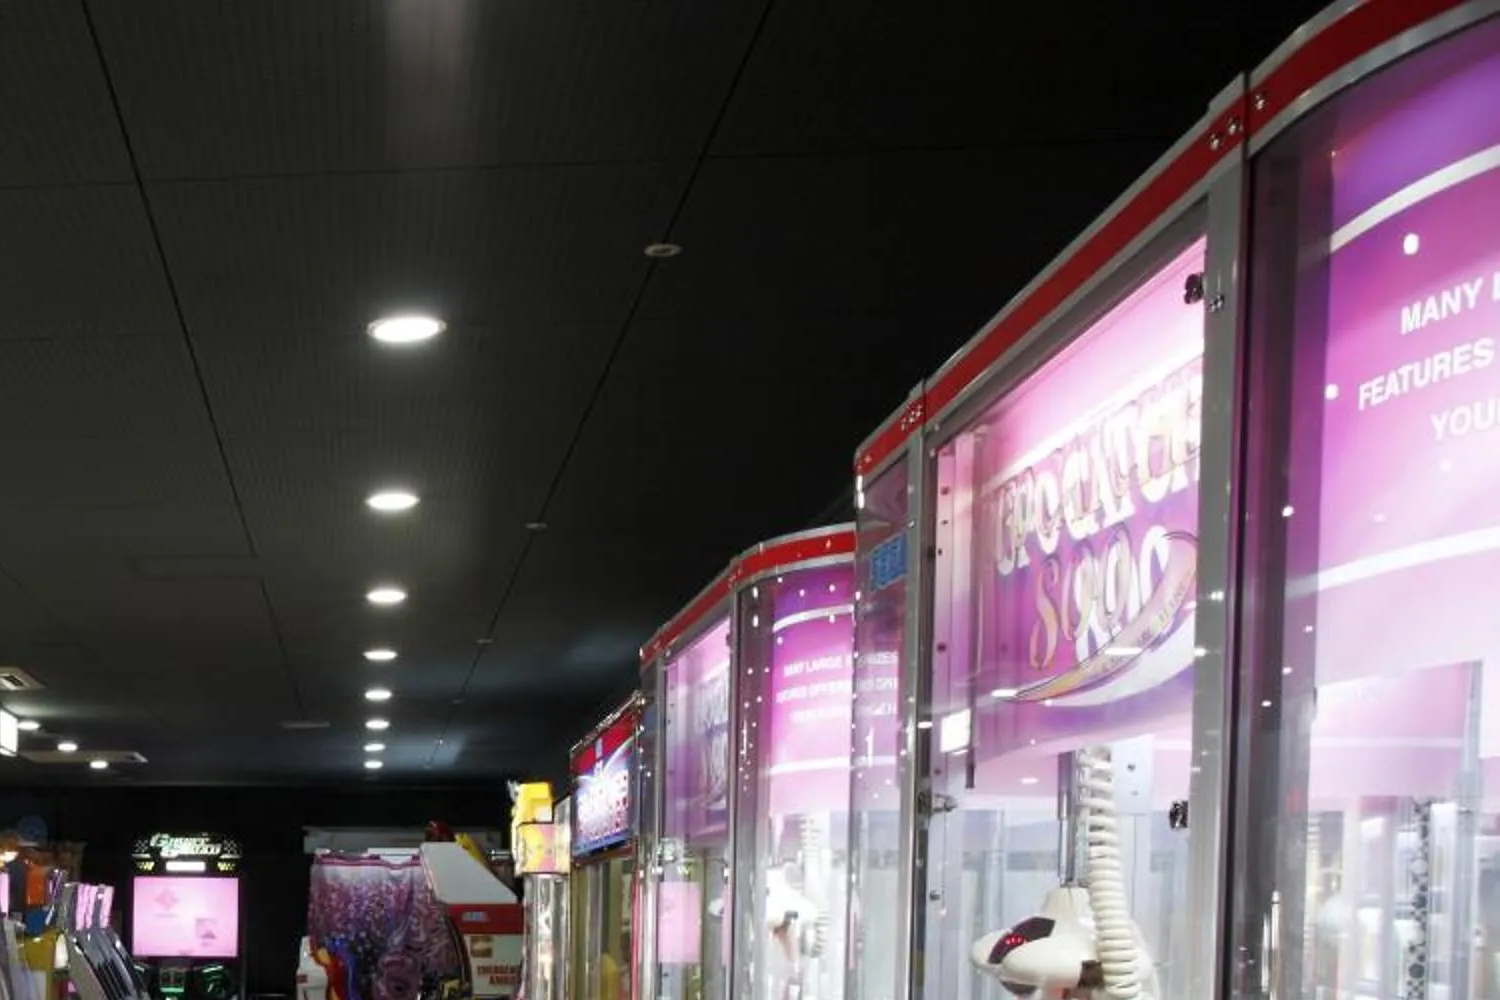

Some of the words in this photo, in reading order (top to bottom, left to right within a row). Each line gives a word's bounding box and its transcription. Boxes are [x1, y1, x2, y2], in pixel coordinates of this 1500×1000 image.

[1400, 276, 1484, 336] MANY
[1358, 337, 1495, 412] FEATURES
[1430, 398, 1500, 442] YOU
